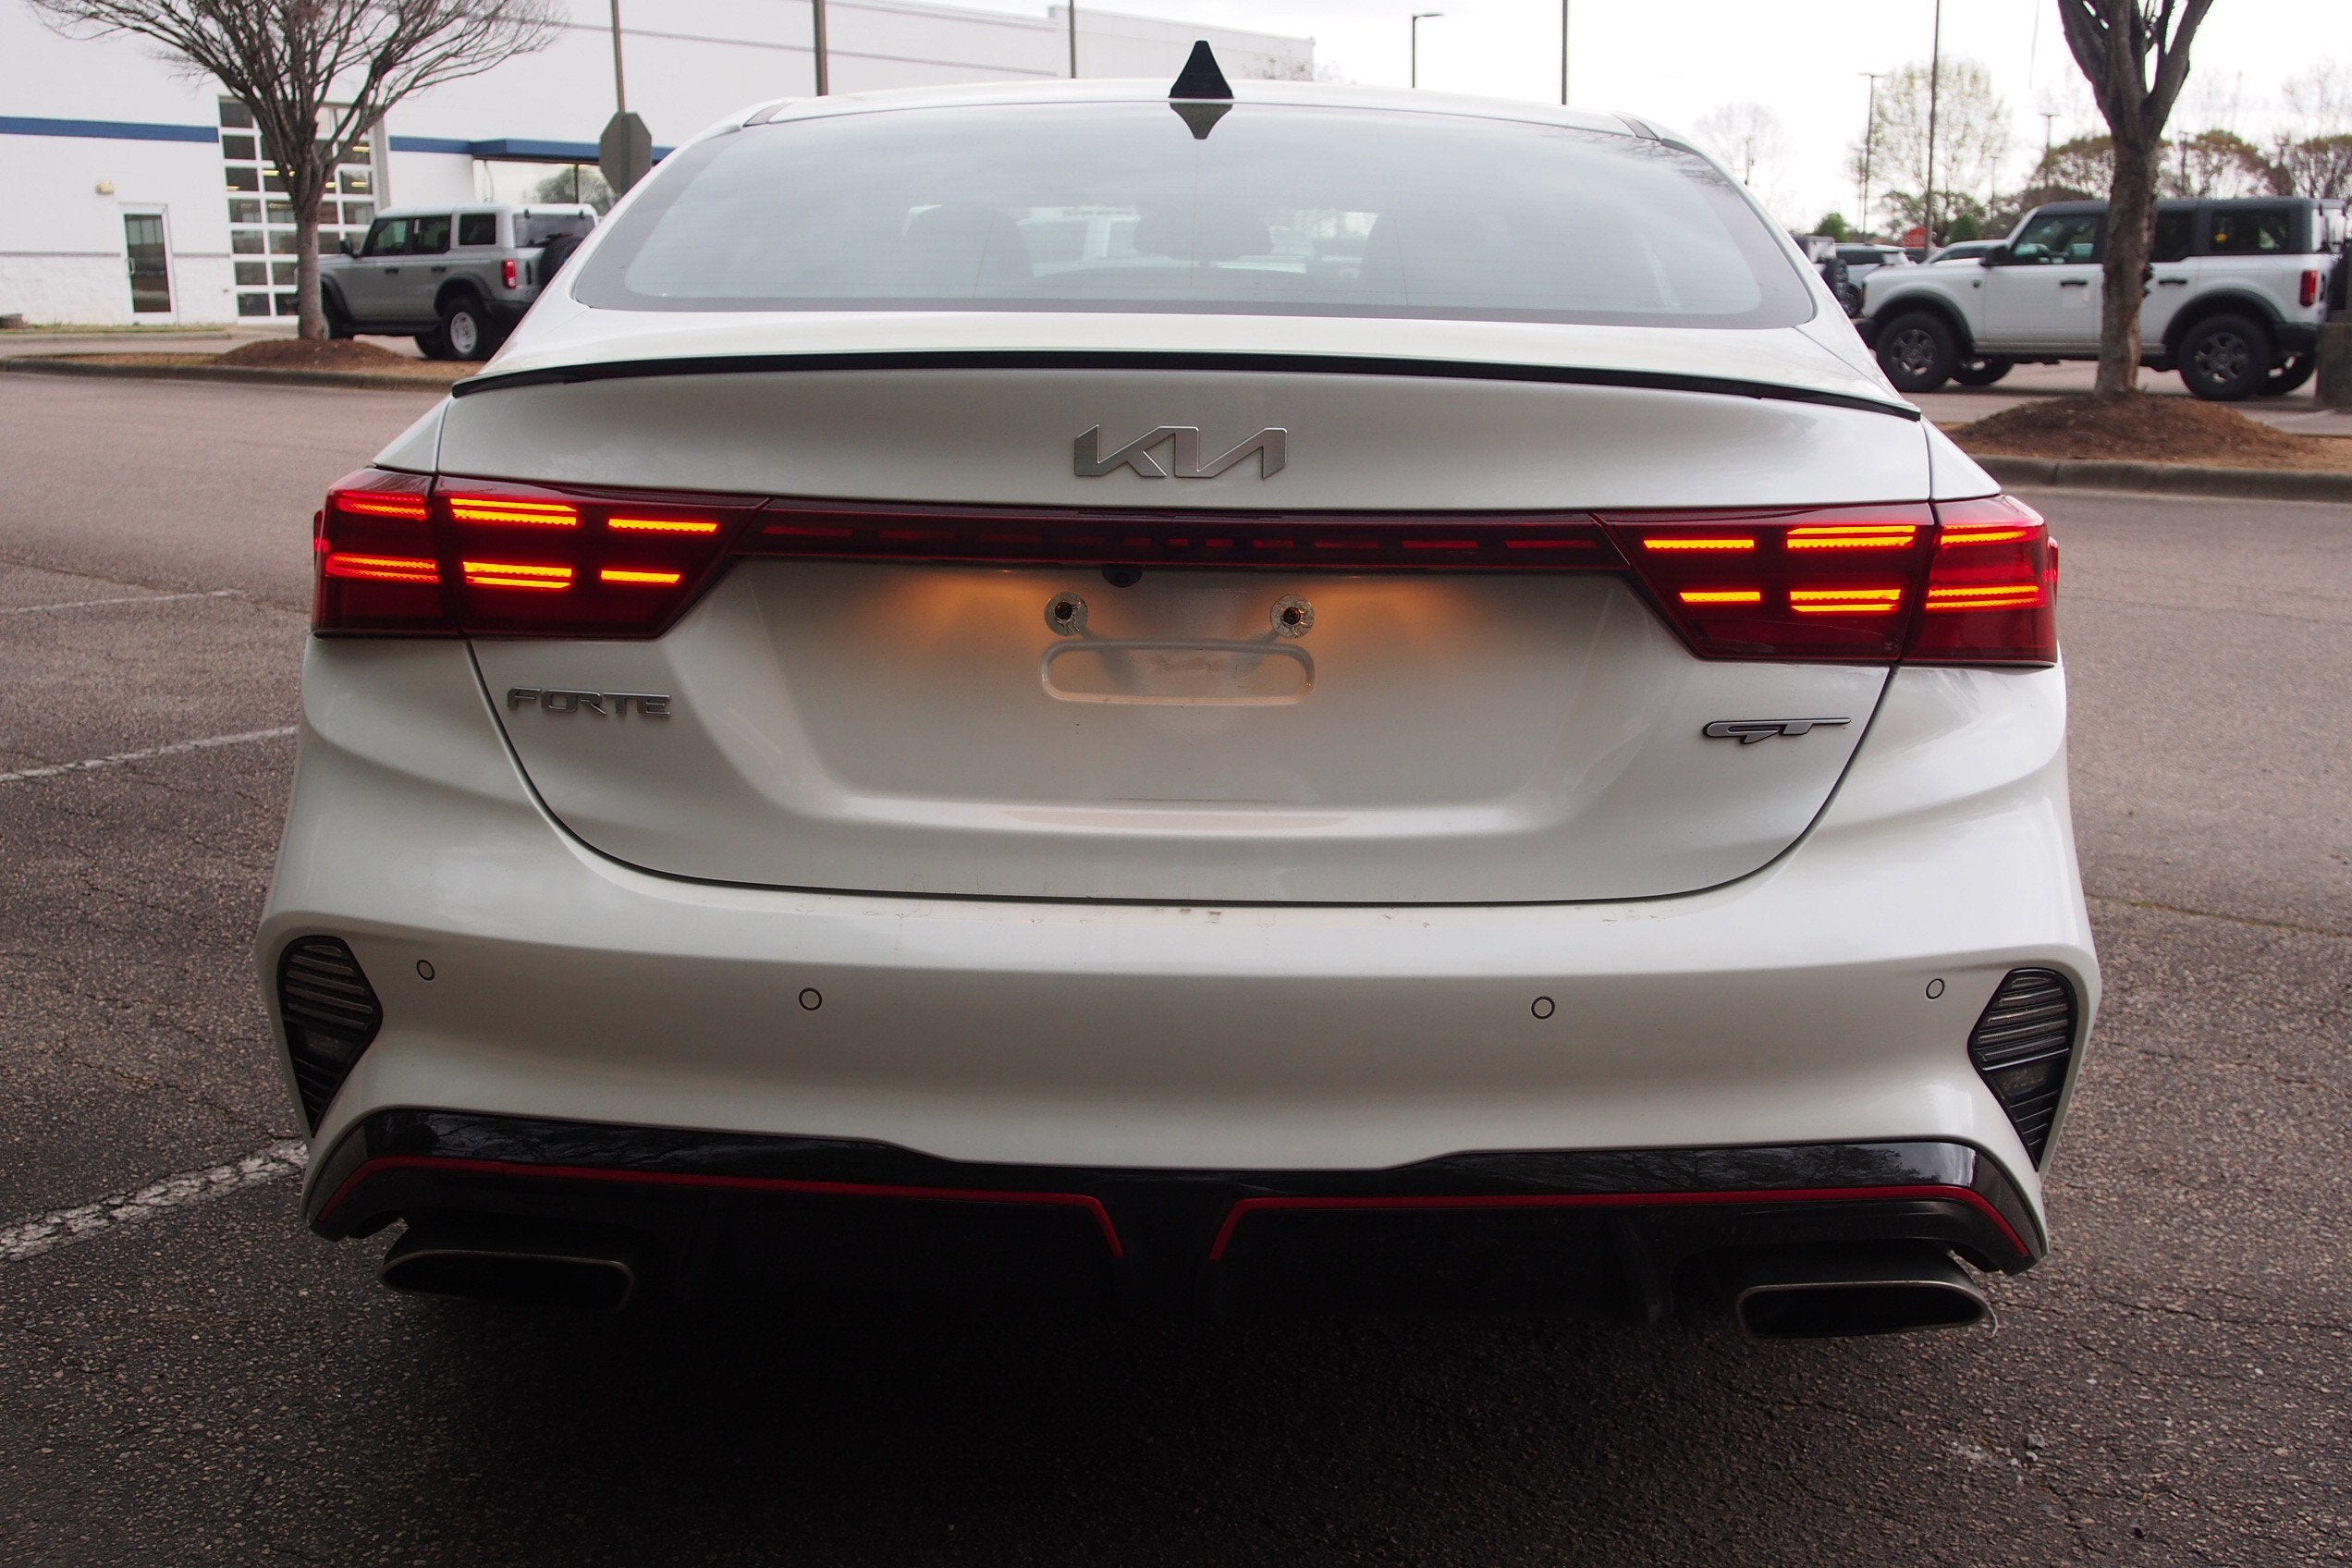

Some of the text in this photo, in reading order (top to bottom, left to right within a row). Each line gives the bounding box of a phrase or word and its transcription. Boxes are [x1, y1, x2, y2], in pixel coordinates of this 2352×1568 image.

[1073, 424, 1287, 480] KIA
[508, 687, 671, 717] FORTE
[1703, 717, 1852, 744] GT
